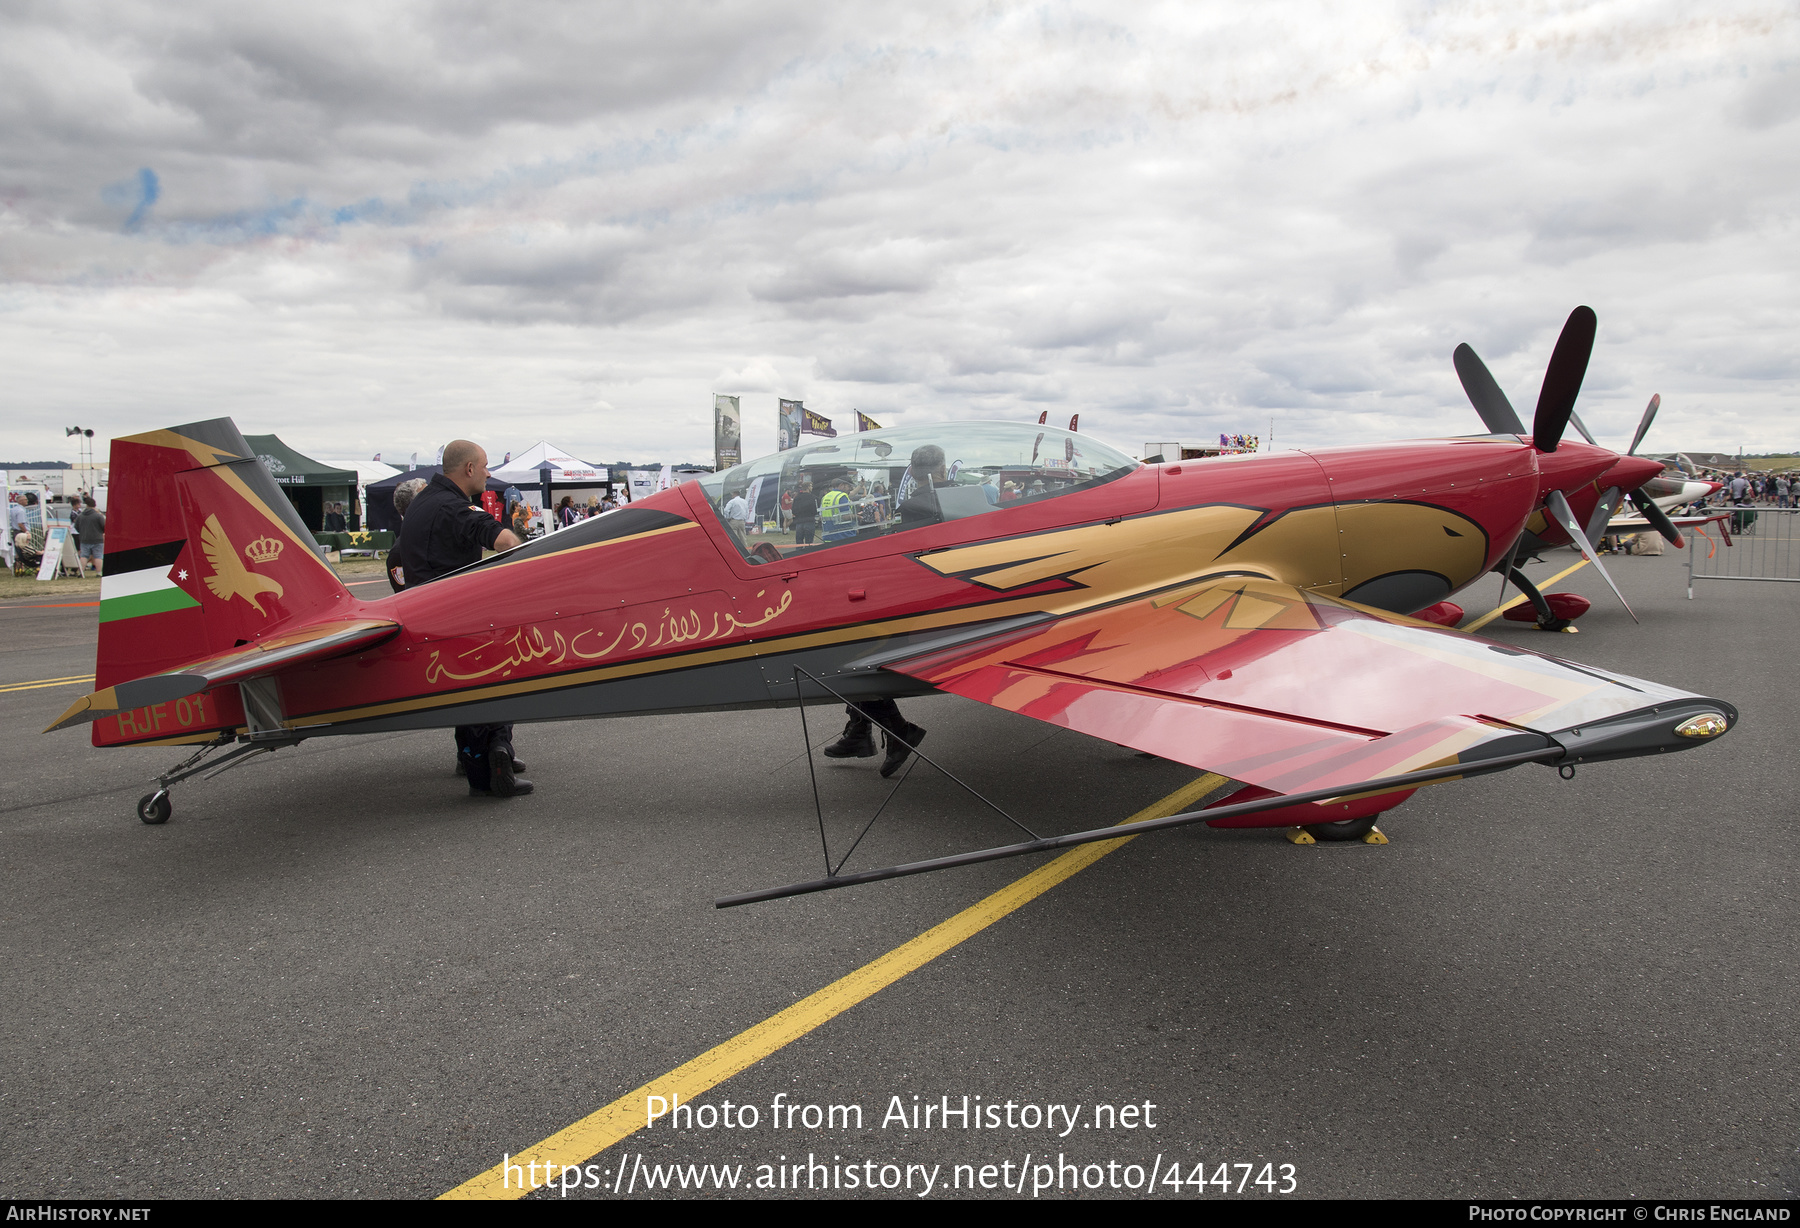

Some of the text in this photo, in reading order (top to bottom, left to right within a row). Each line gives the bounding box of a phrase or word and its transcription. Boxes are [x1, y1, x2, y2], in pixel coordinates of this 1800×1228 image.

[291, 475, 305, 484] Hill
[116, 696, 206, 736] RJF 01
